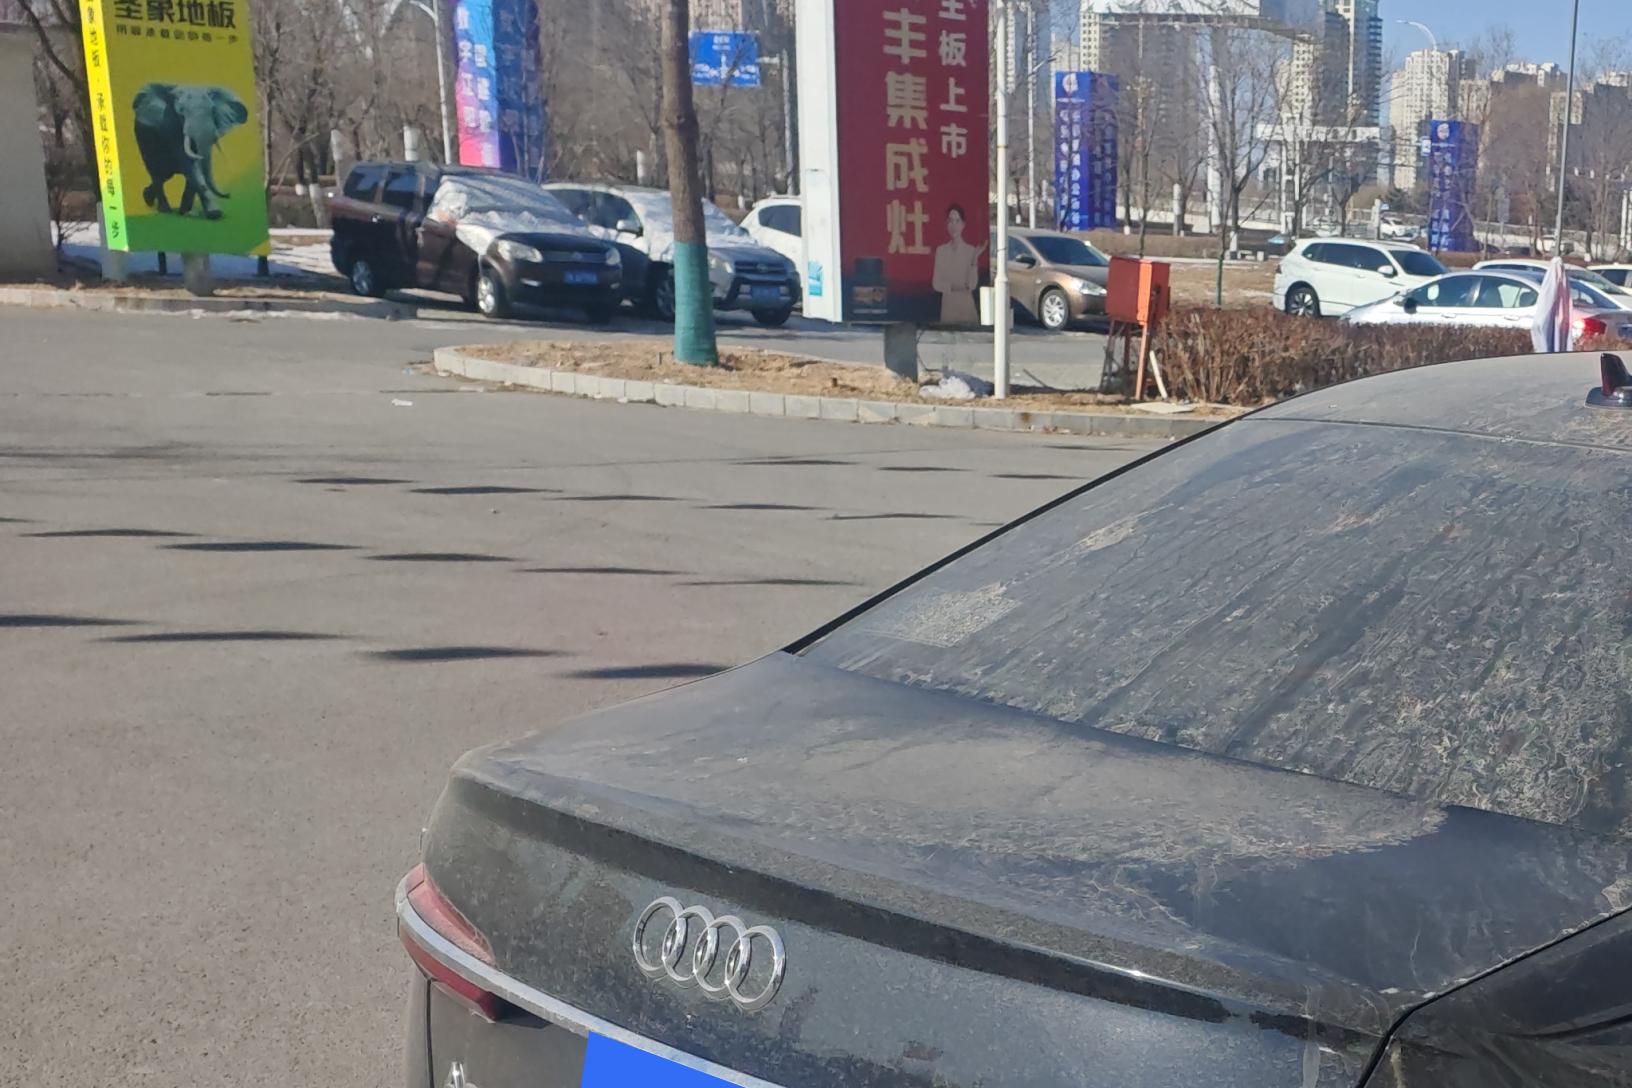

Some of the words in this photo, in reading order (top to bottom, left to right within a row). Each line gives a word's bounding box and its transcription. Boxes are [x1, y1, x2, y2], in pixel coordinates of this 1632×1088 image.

[114, 0, 236, 28] 圣象地板
[881, 8, 932, 256] 丰集成灶
